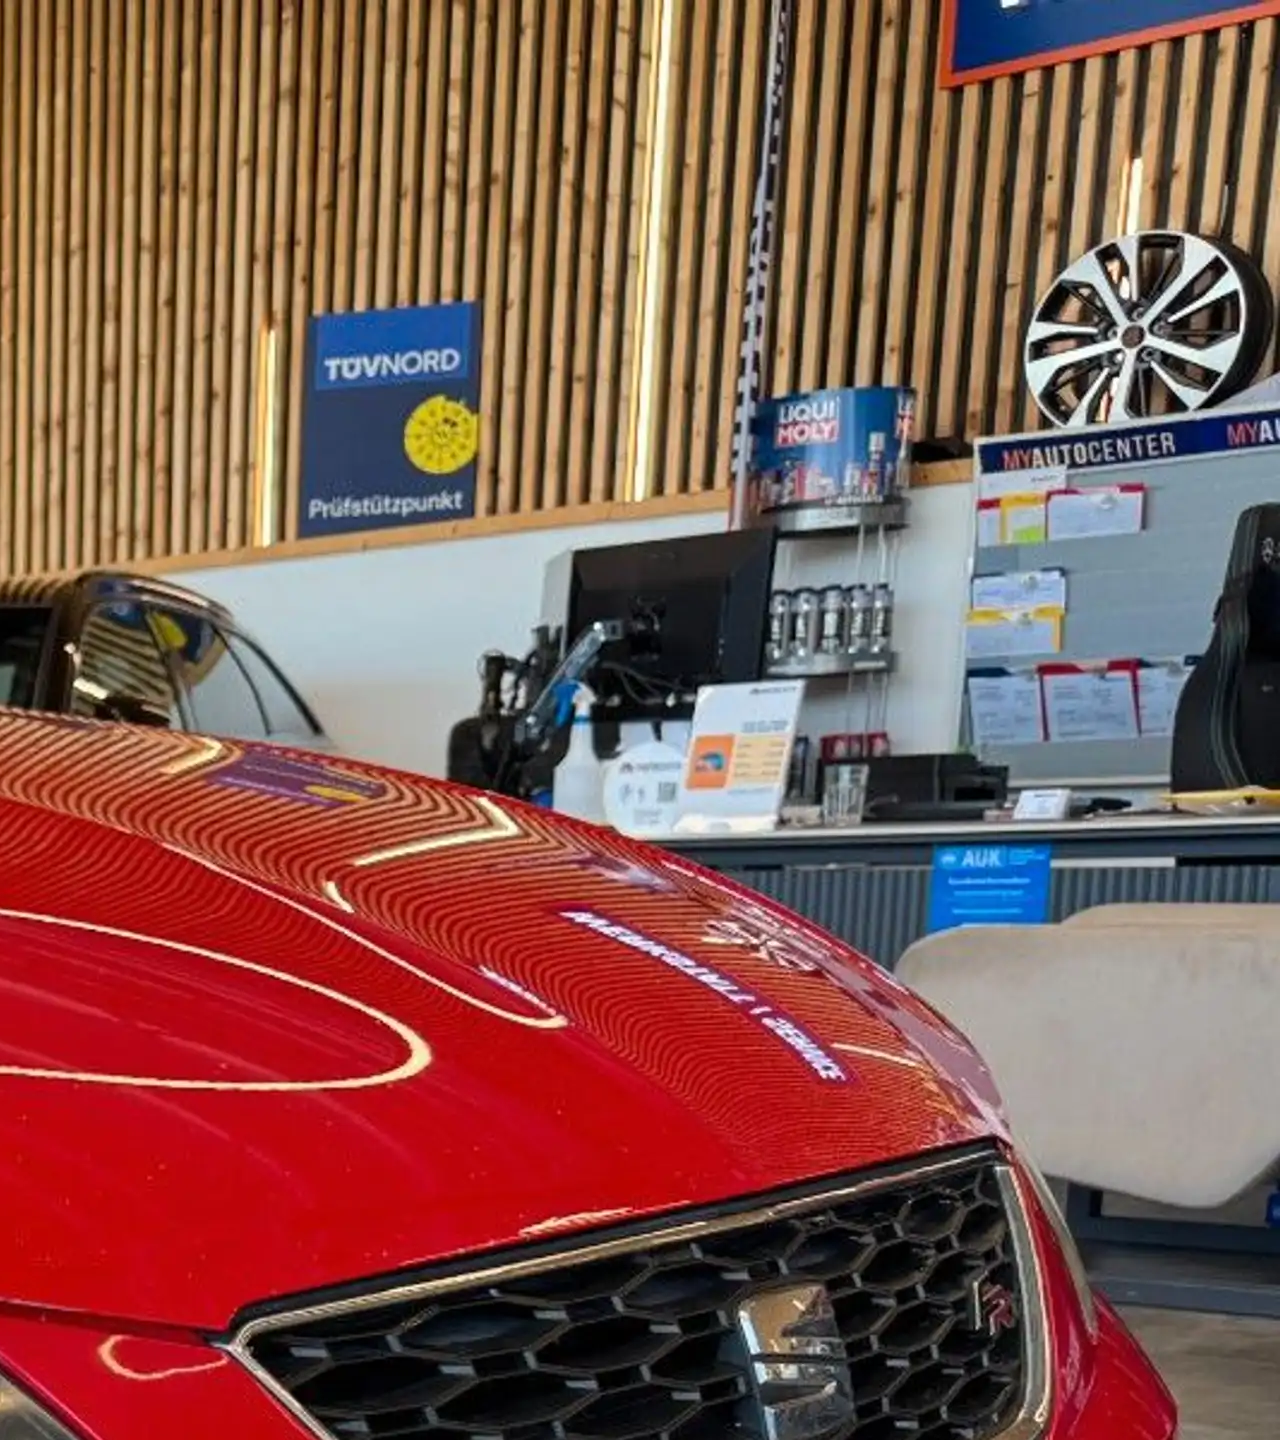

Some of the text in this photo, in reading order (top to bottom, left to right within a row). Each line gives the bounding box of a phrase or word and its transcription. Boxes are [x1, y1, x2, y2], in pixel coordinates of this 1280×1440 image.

[777, 420, 839, 447] MOLY
[1002, 431, 1176, 470] MYAUTOCENTER
[308, 490, 463, 518] Prüfstützpunkt
